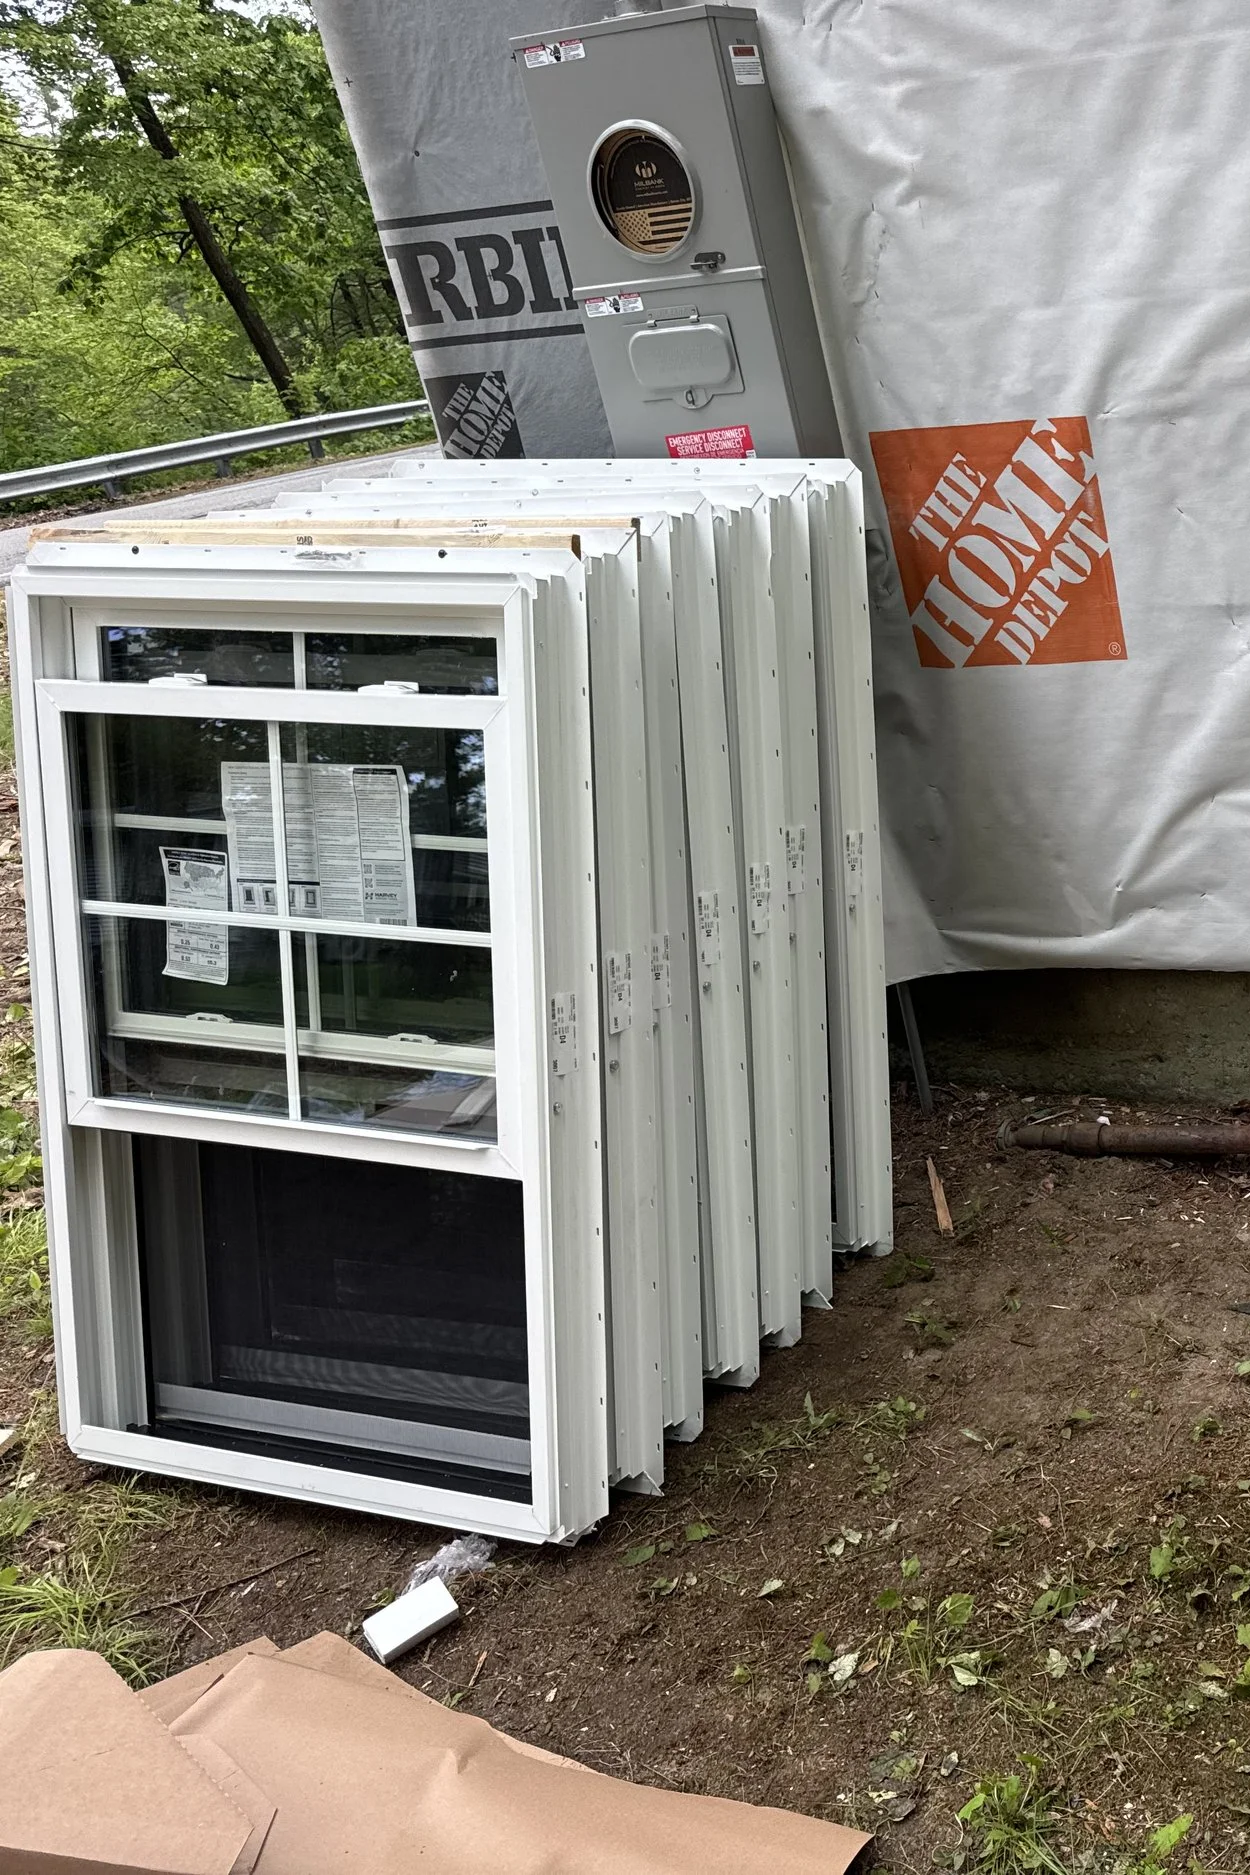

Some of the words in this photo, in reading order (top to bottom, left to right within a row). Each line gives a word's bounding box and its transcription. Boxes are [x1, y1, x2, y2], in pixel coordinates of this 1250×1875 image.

[634, 178, 665, 188] MILBANK
[442, 383, 474, 421] THE
[443, 371, 508, 458] HOME
[668, 433, 706, 448] EMERGENCY
[706, 427, 747, 442] DISCONNECT
[677, 443, 705, 456] SERVICE
[704, 438, 744, 452] DISCONNECT
[908, 452, 987, 552] THE
[910, 418, 1097, 669] HOME
[994, 510, 1110, 665] DEPOT
[706, 929, 712, 937] D4
[655, 972, 661, 980] D4
[560, 1035, 567, 1043] D4
